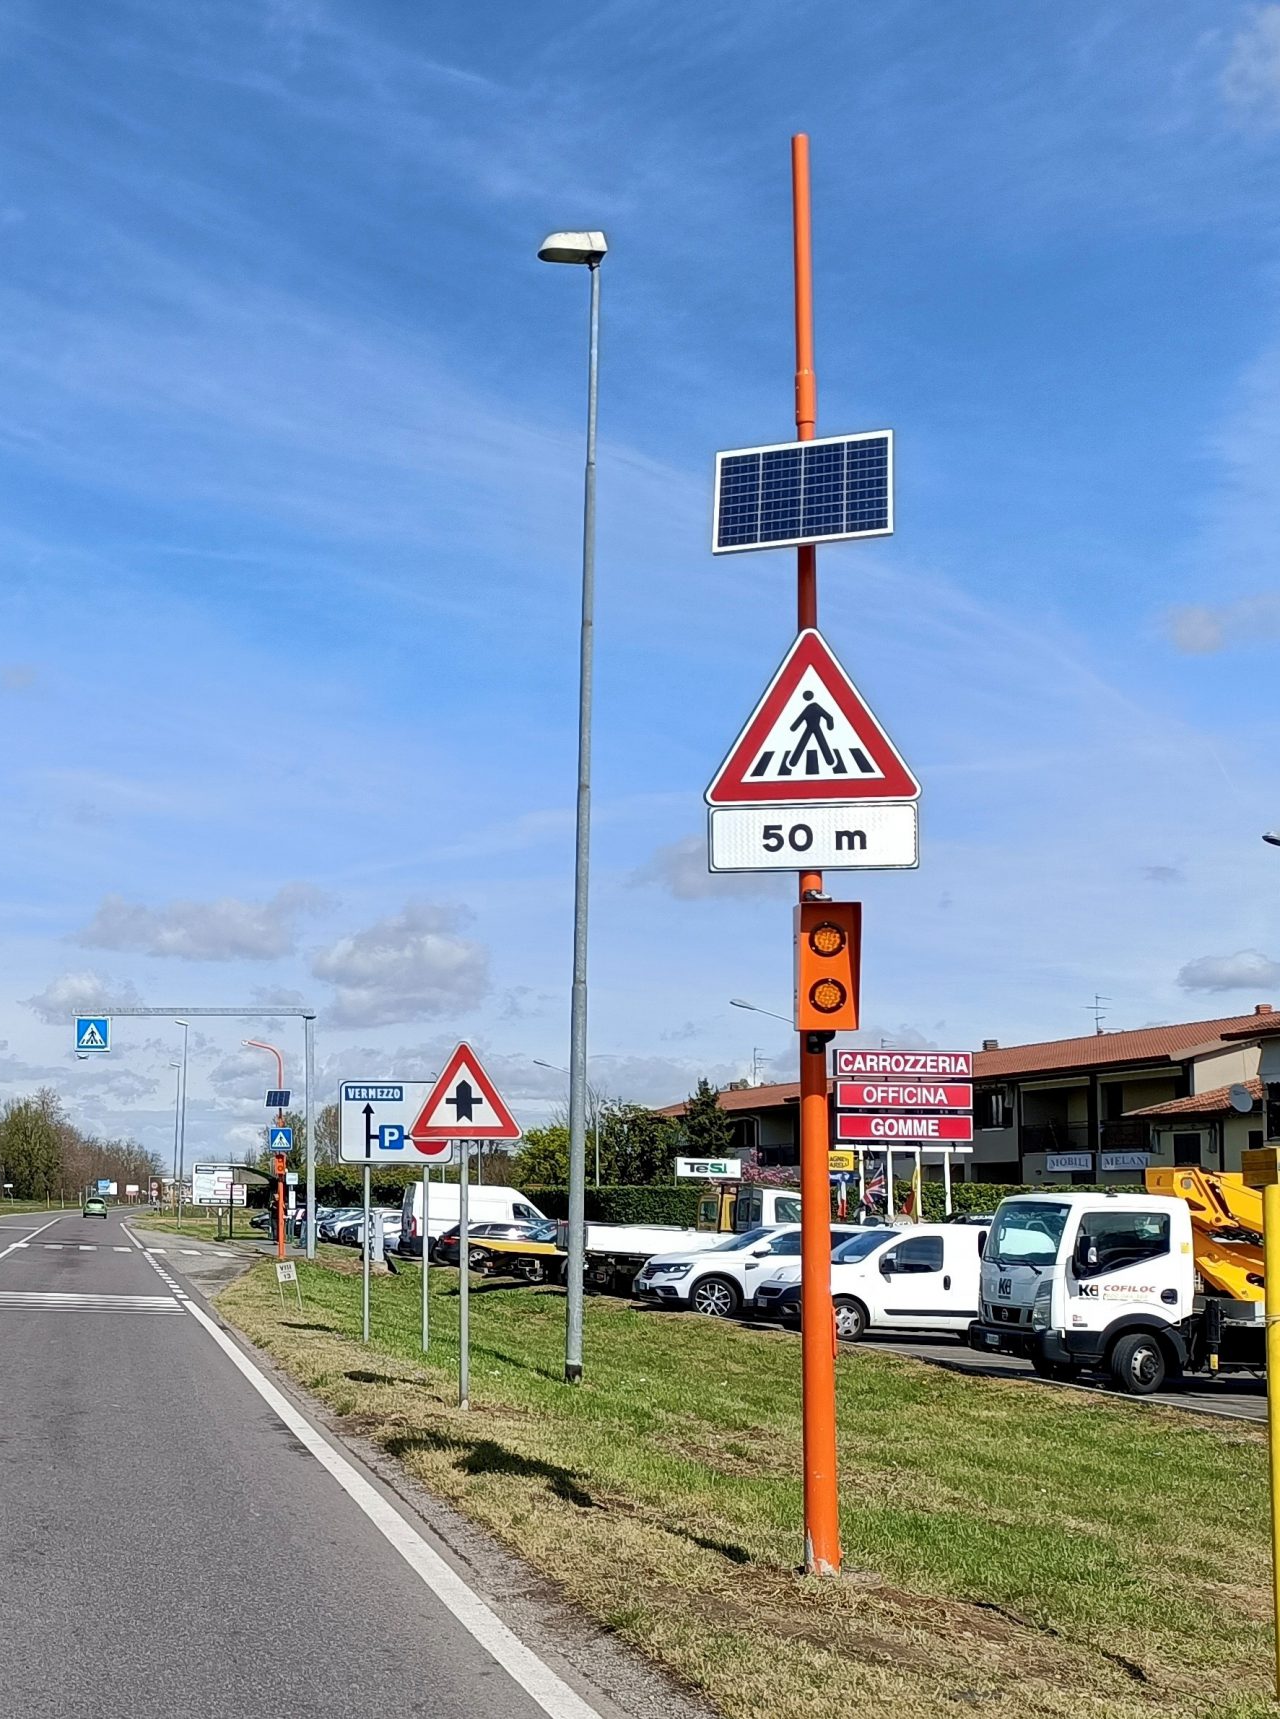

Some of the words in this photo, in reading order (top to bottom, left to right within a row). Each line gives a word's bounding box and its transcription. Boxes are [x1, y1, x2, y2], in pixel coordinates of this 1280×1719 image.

[762, 823, 814, 853] 50
[834, 829, 868, 851] m
[840, 1053, 969, 1074] CARROZZERIA
[347, 1087, 401, 1099] VERMEZZO
[862, 1086, 949, 1105] OFFICINA
[870, 1117, 940, 1137] GOMME
[383, 1127, 400, 1147] P
[1049, 1156, 1090, 1169] MOBILI
[1103, 1284, 1157, 1293] COFILOC
